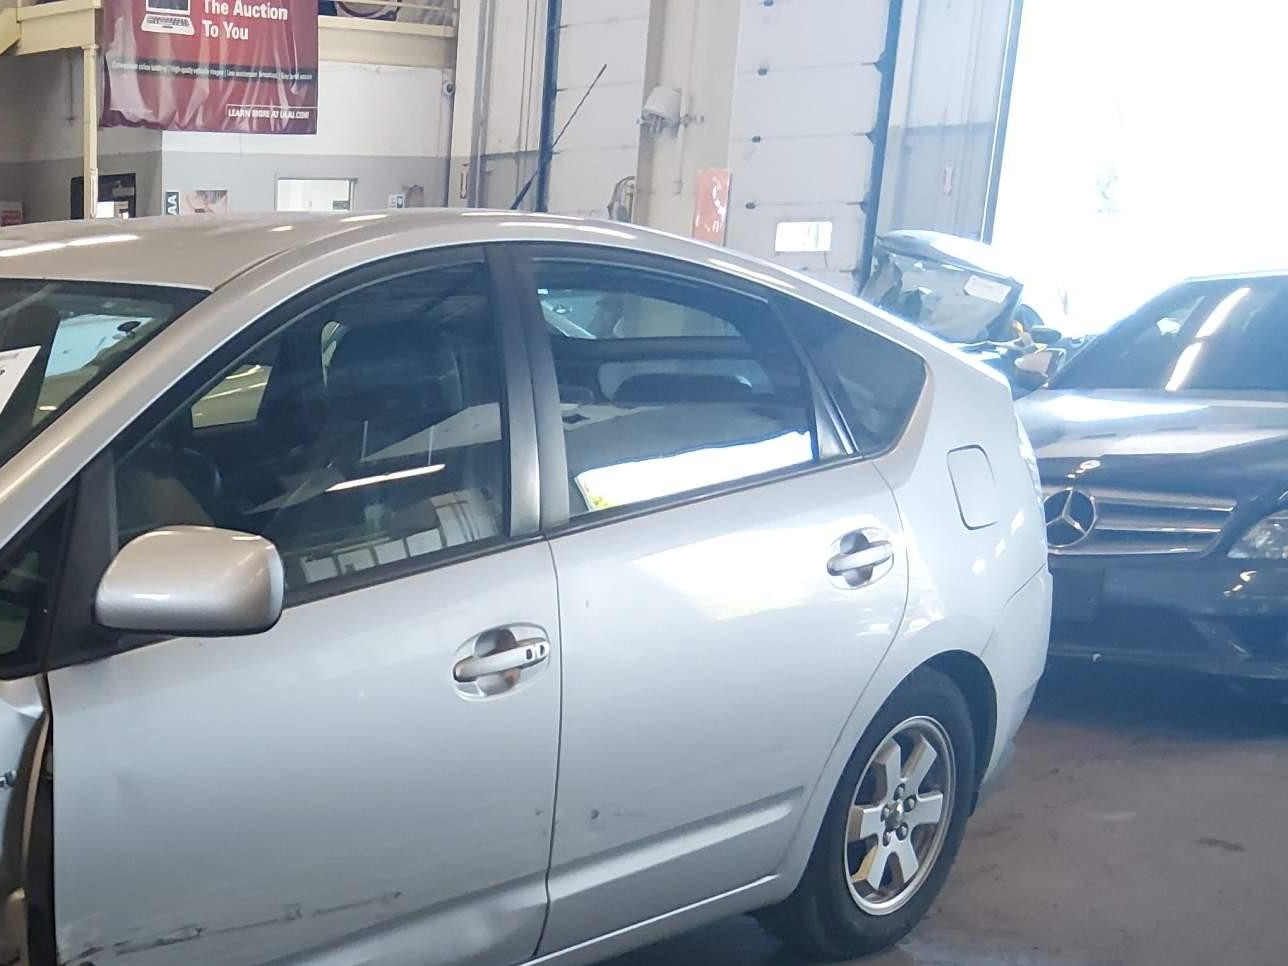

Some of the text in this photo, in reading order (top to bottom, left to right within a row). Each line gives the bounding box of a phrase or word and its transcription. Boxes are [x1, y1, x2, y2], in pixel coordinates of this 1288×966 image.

[204, 0, 288, 20] The Auction
[202, 20, 249, 40] To You
[228, 108, 251, 117] LEARN
